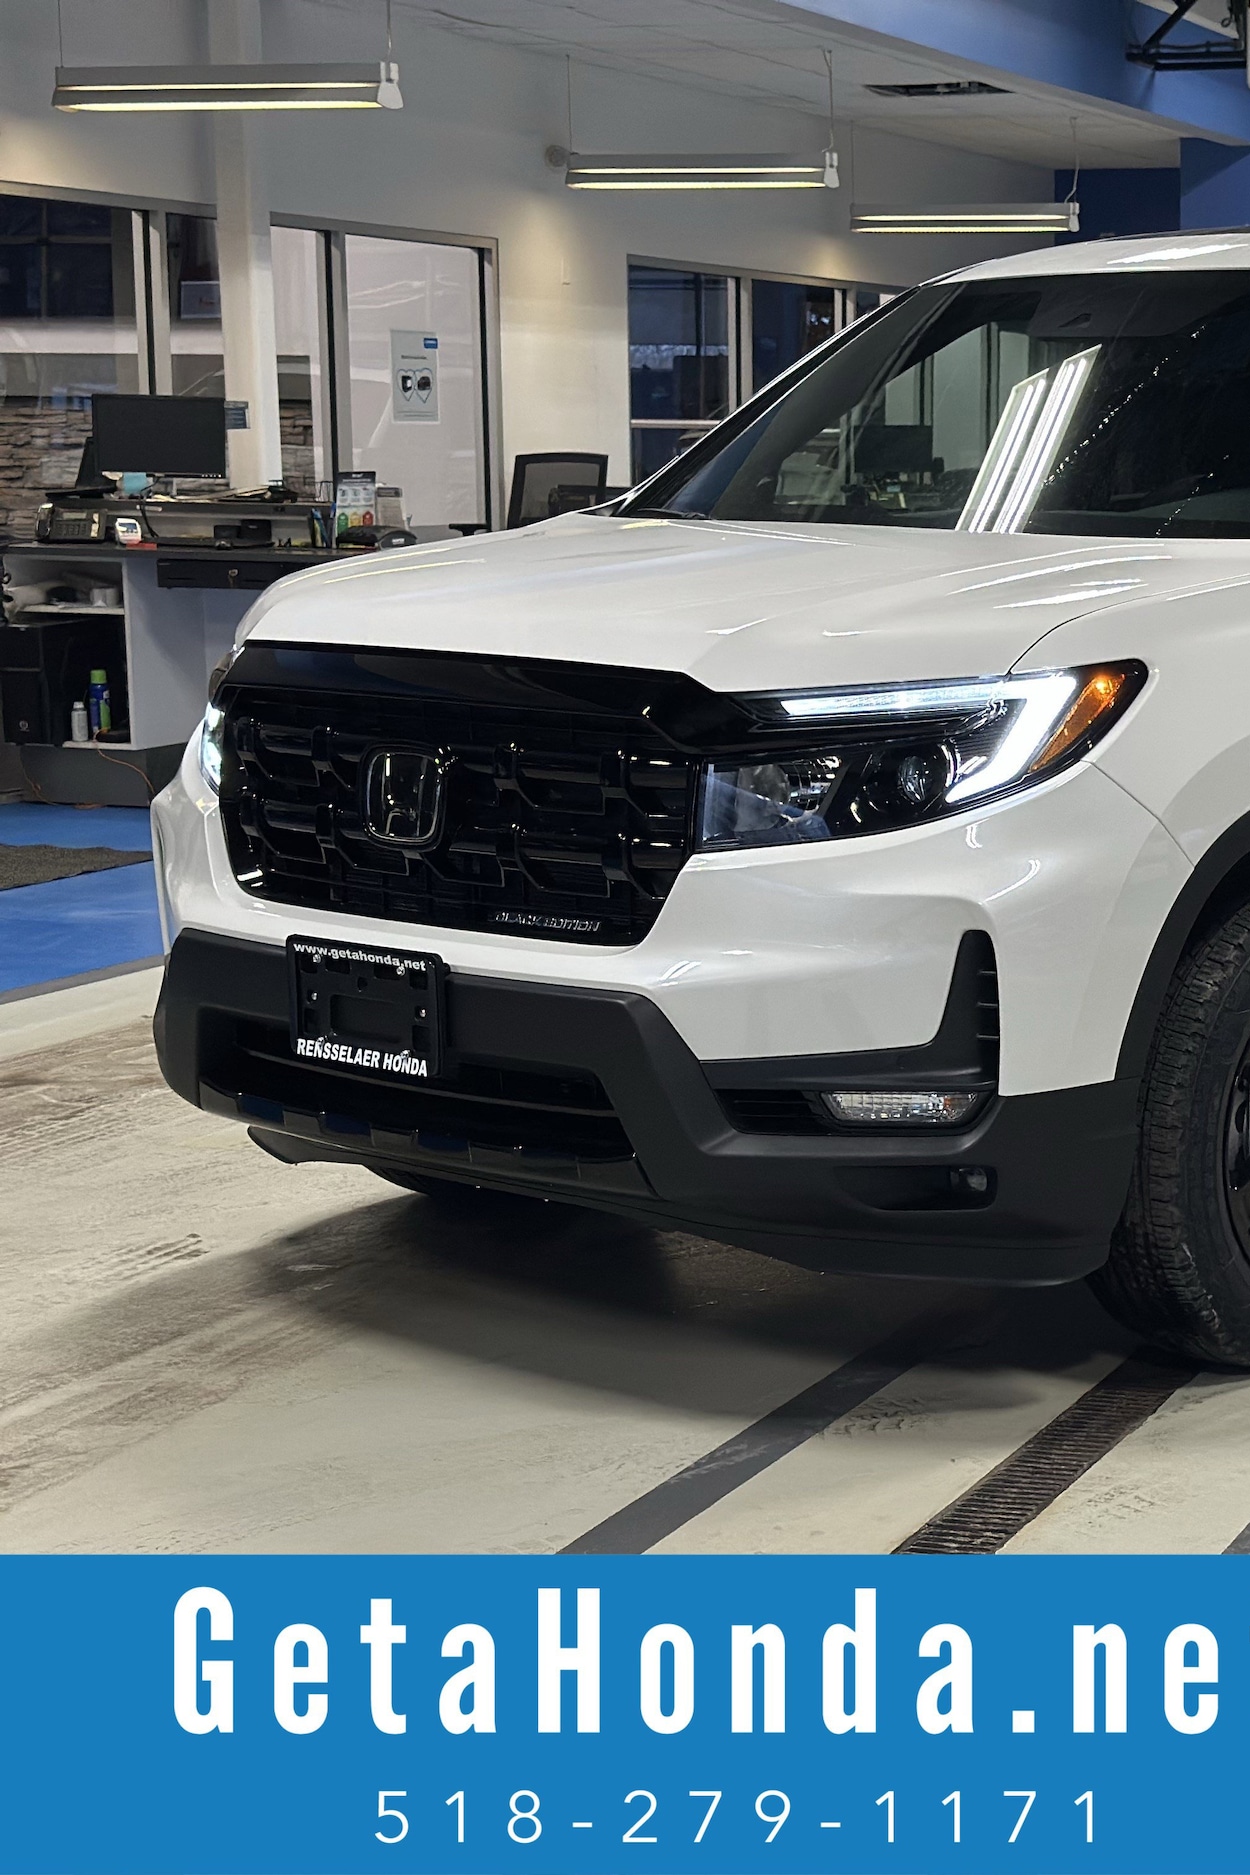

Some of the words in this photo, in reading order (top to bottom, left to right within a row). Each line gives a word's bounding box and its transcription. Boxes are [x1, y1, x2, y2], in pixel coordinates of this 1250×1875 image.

[293, 943, 427, 972] www.getahonda.net
[296, 1037, 382, 1069] RENSSELAER
[382, 1051, 428, 1078] HONDA
